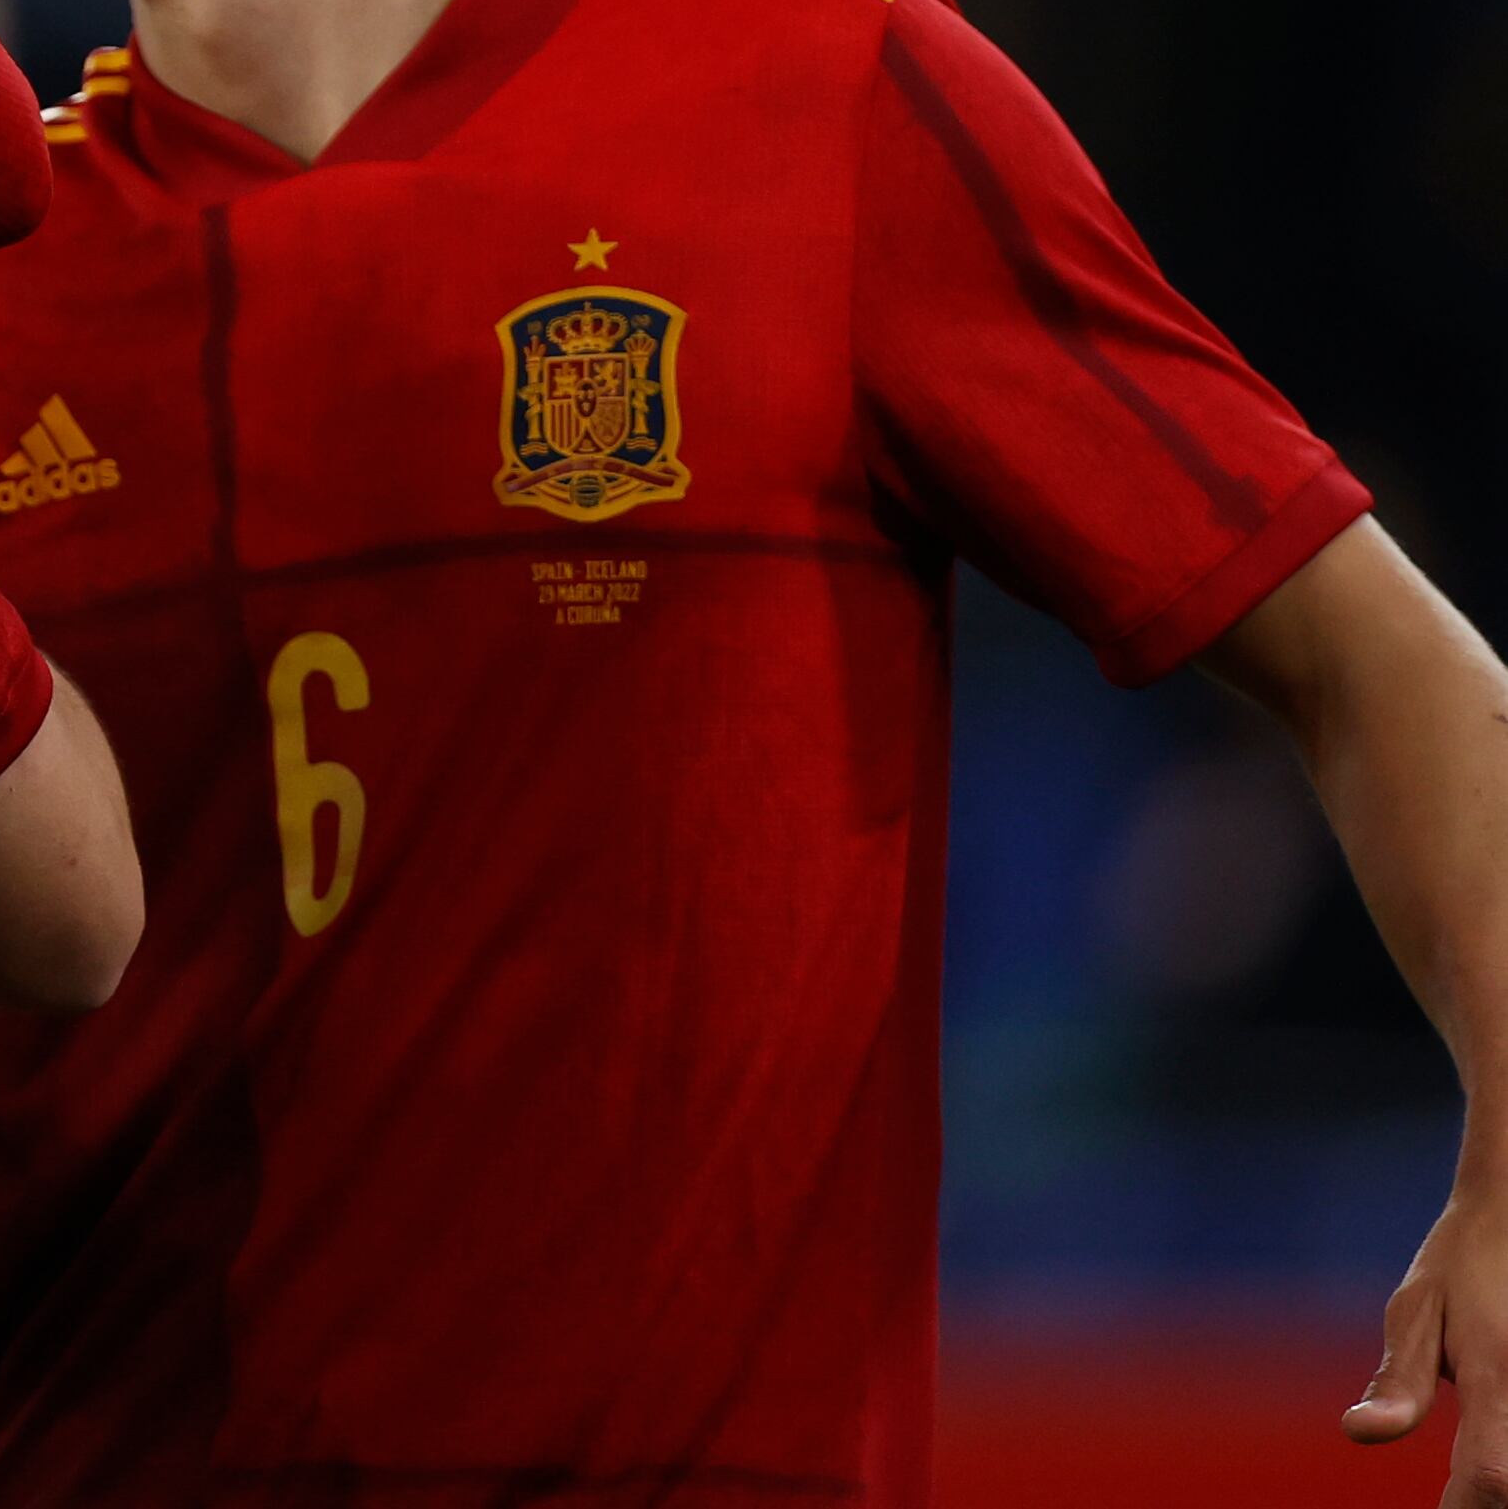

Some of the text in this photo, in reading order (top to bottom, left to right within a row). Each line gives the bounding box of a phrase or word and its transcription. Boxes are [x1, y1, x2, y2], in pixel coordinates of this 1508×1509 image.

[530, 561, 574, 582] SPAIN
[584, 559, 648, 581] ICELAND
[538, 581, 642, 604] 29 MARCH 2022
[266, 630, 371, 938] 6
